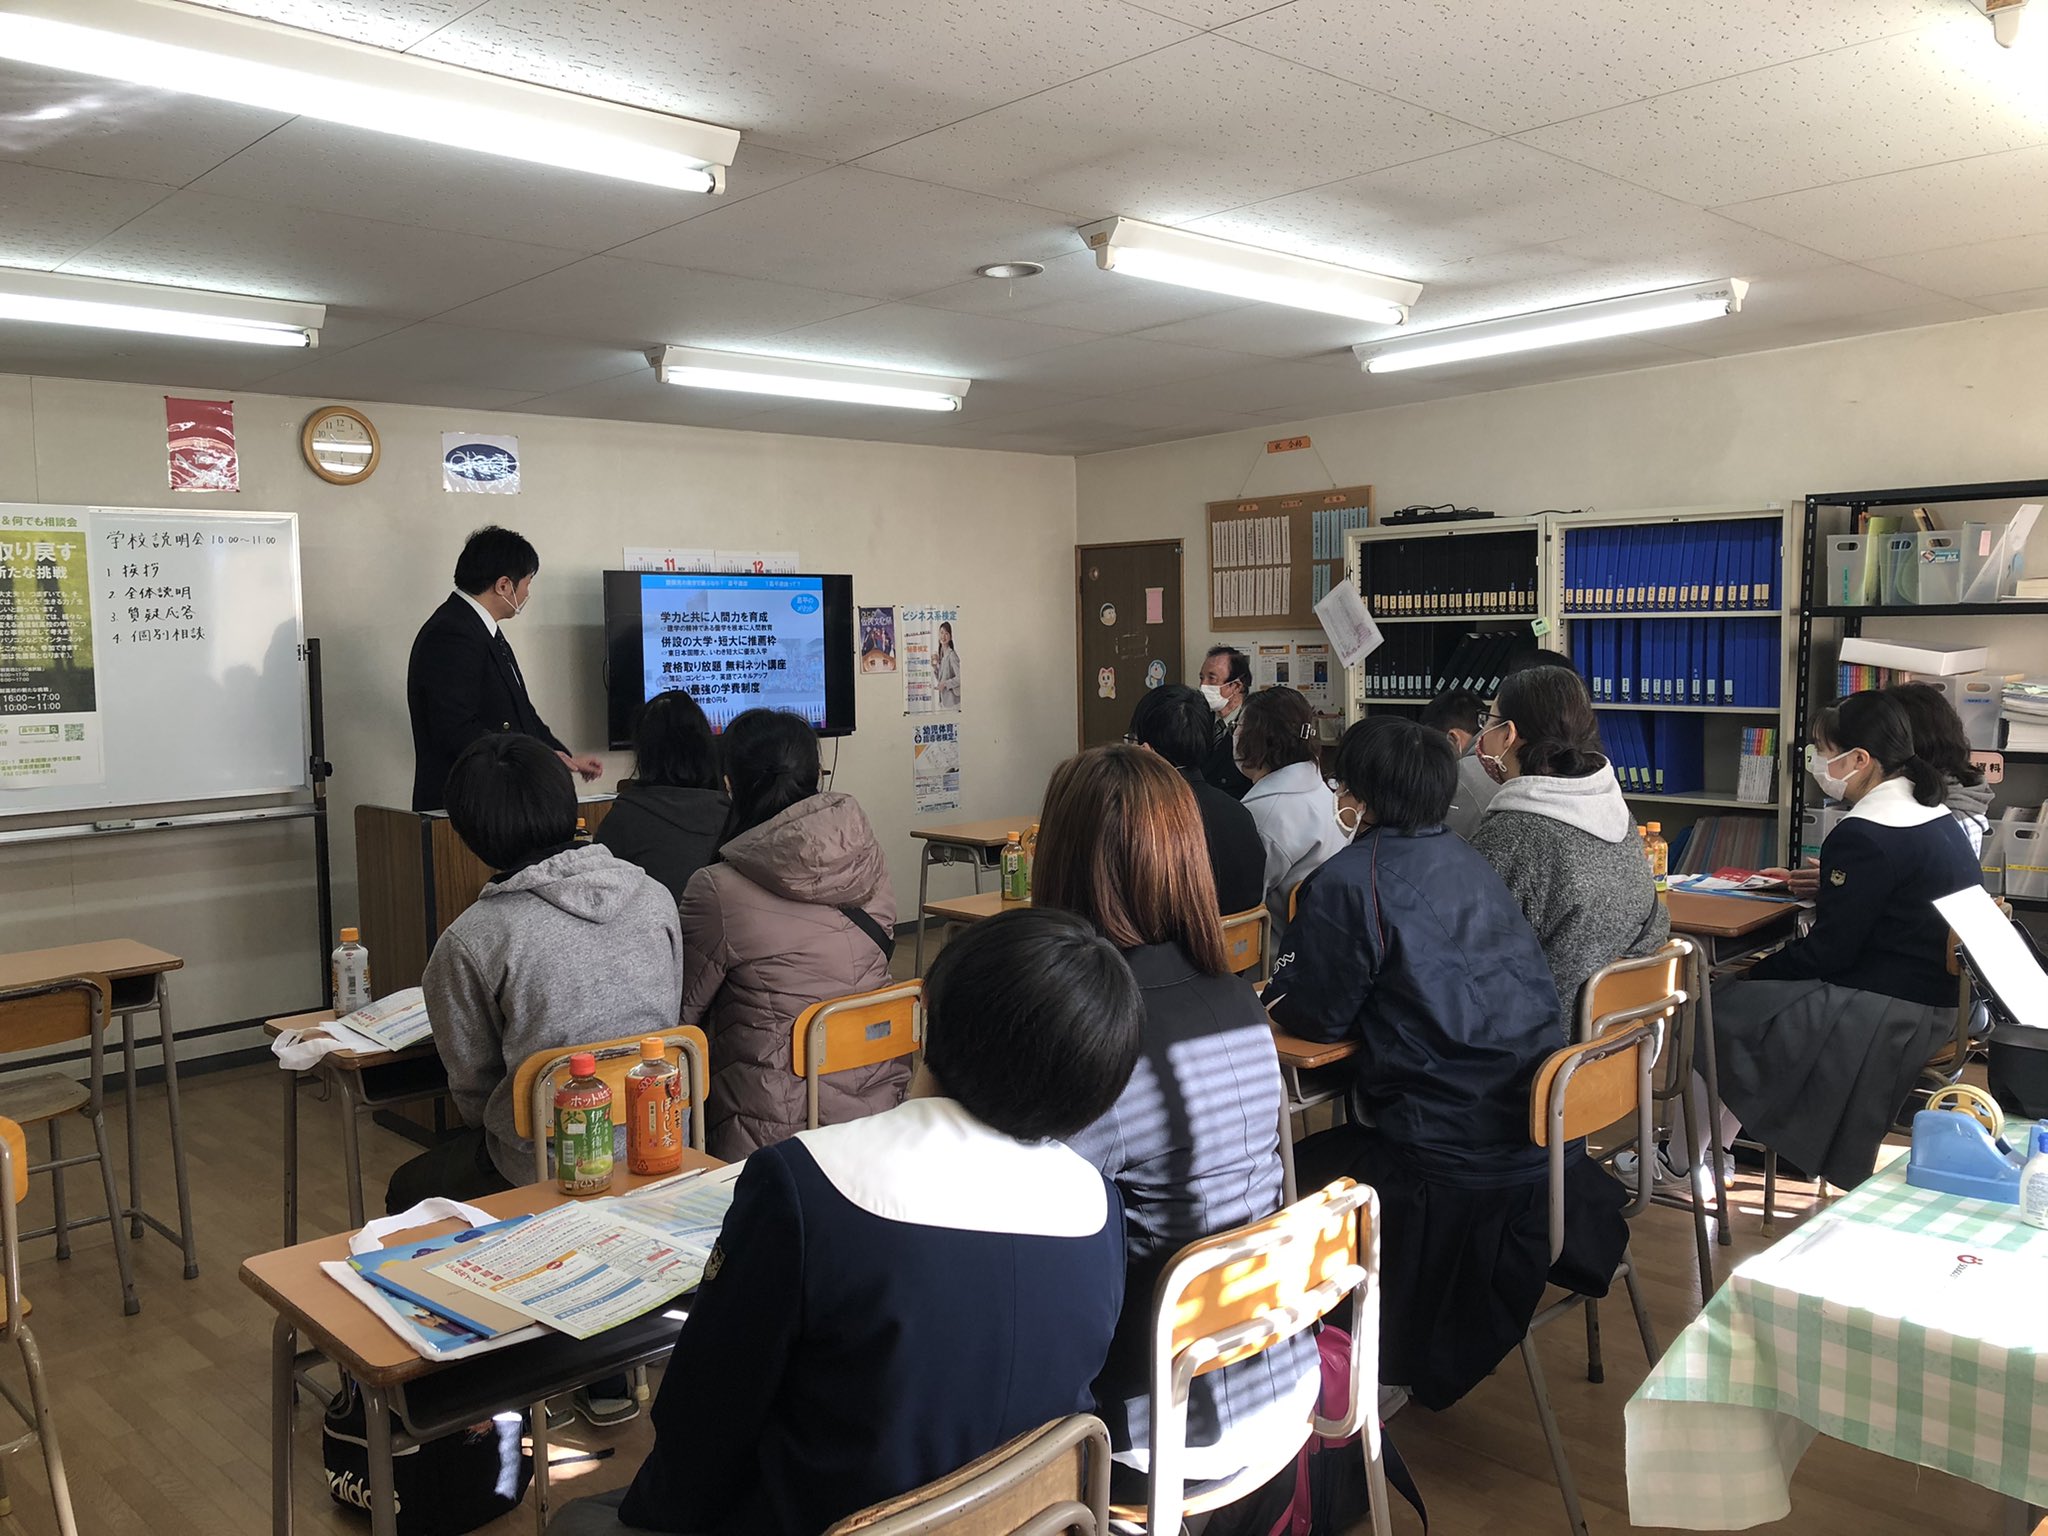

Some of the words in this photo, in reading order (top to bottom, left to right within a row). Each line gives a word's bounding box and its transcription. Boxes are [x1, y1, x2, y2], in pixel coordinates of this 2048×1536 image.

[325, 421, 333, 430] 11
[335, 418, 345, 427] 12
[317, 430, 326, 438] 10
[358, 431, 363, 439] 2
[106, 530, 206, 549] 学校説明会
[0, 541, 77, 562] 取り戻す
[122, 562, 160, 578] 挨拶
[664, 558, 676, 571] 11
[752, 560, 764, 573] 12
[124, 586, 192, 600] 全体説明
[127, 604, 197, 623] 質疑応答
[660, 611, 769, 623] 学力と共に人間力を育成
[902, 611, 957, 622] ビジネス系検定
[130, 626, 206, 643] 個別相談
[661, 635, 777, 648] 併設の大学・短大に推薦枠
[662, 660, 722, 673] 資格取り放題
[725, 659, 787, 671] 無料ネット講座
[922, 723, 954, 735] 幼児体育
[661, 1095, 677, 1148] ほうじ茶
[591, 1110, 603, 1160] 伊右衛門
